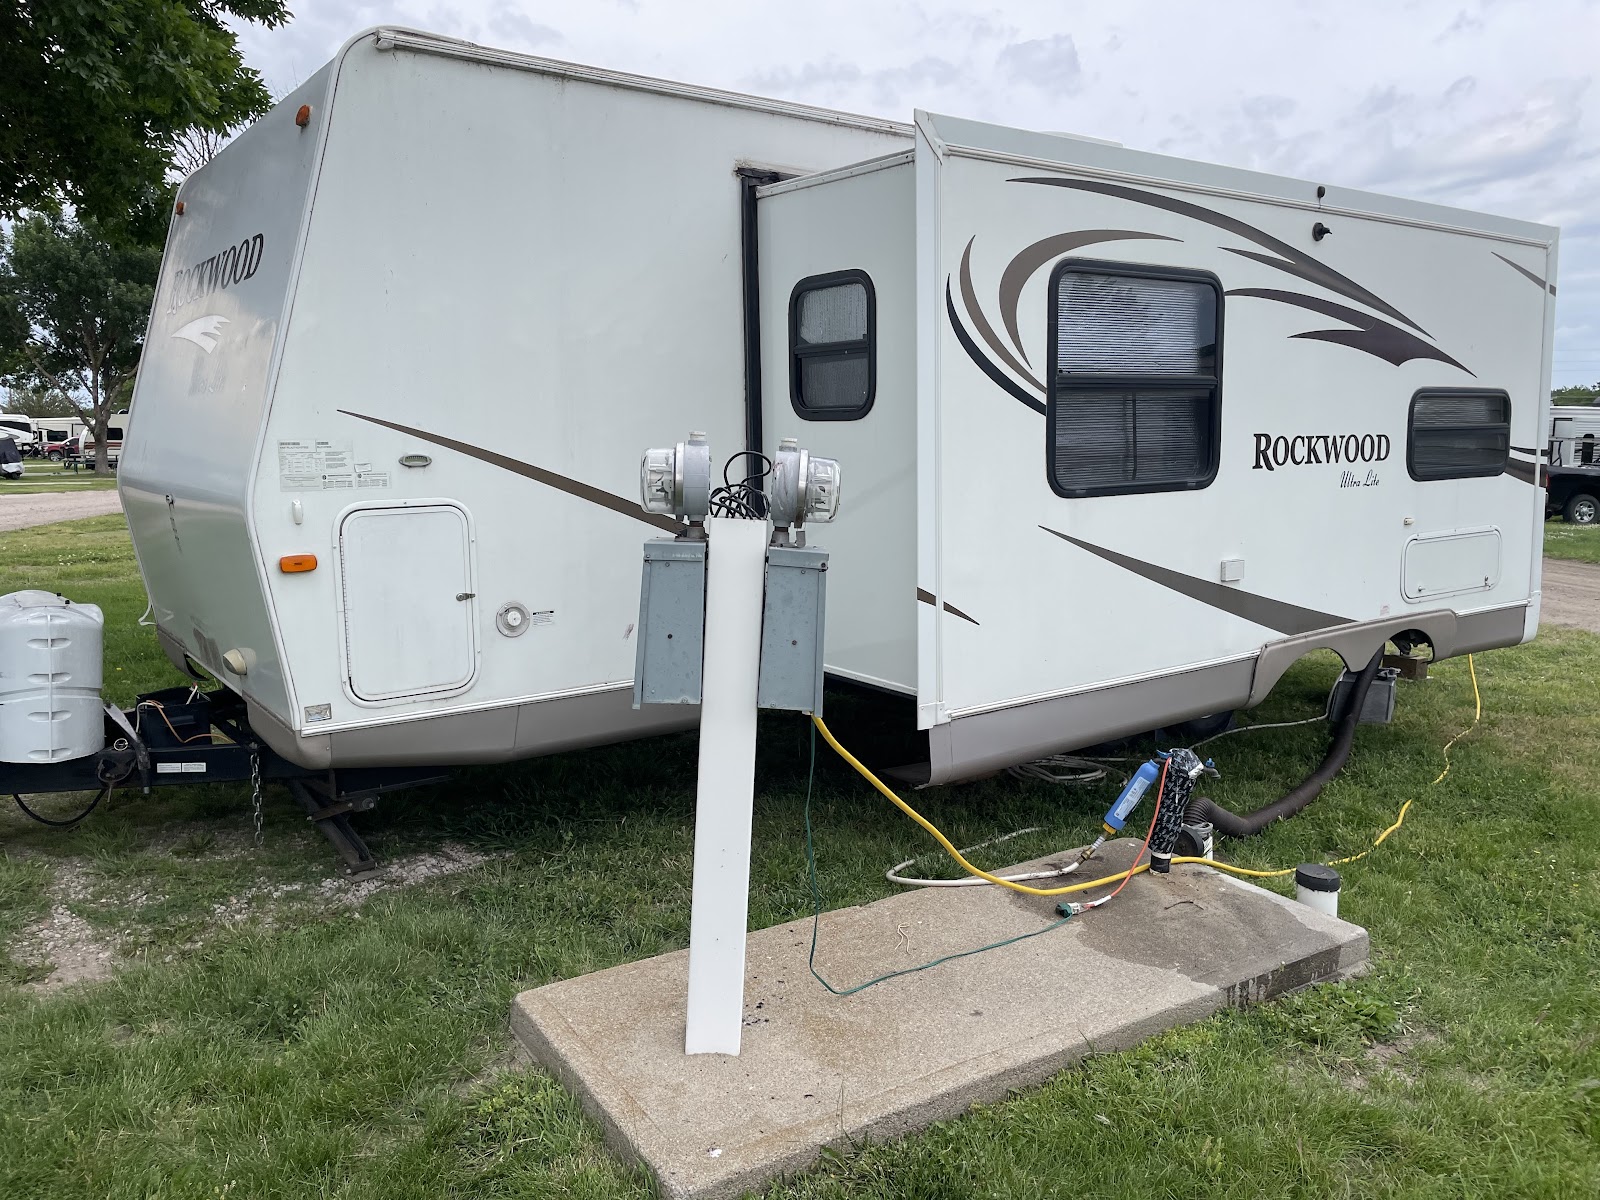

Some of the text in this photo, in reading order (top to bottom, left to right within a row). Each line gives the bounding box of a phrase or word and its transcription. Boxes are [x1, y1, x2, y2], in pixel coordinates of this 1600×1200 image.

[167, 233, 264, 315] ROCKWOOD
[1252, 433, 1391, 471] ROCKWOOD
[1340, 469, 1380, 488] Ultra Lite
